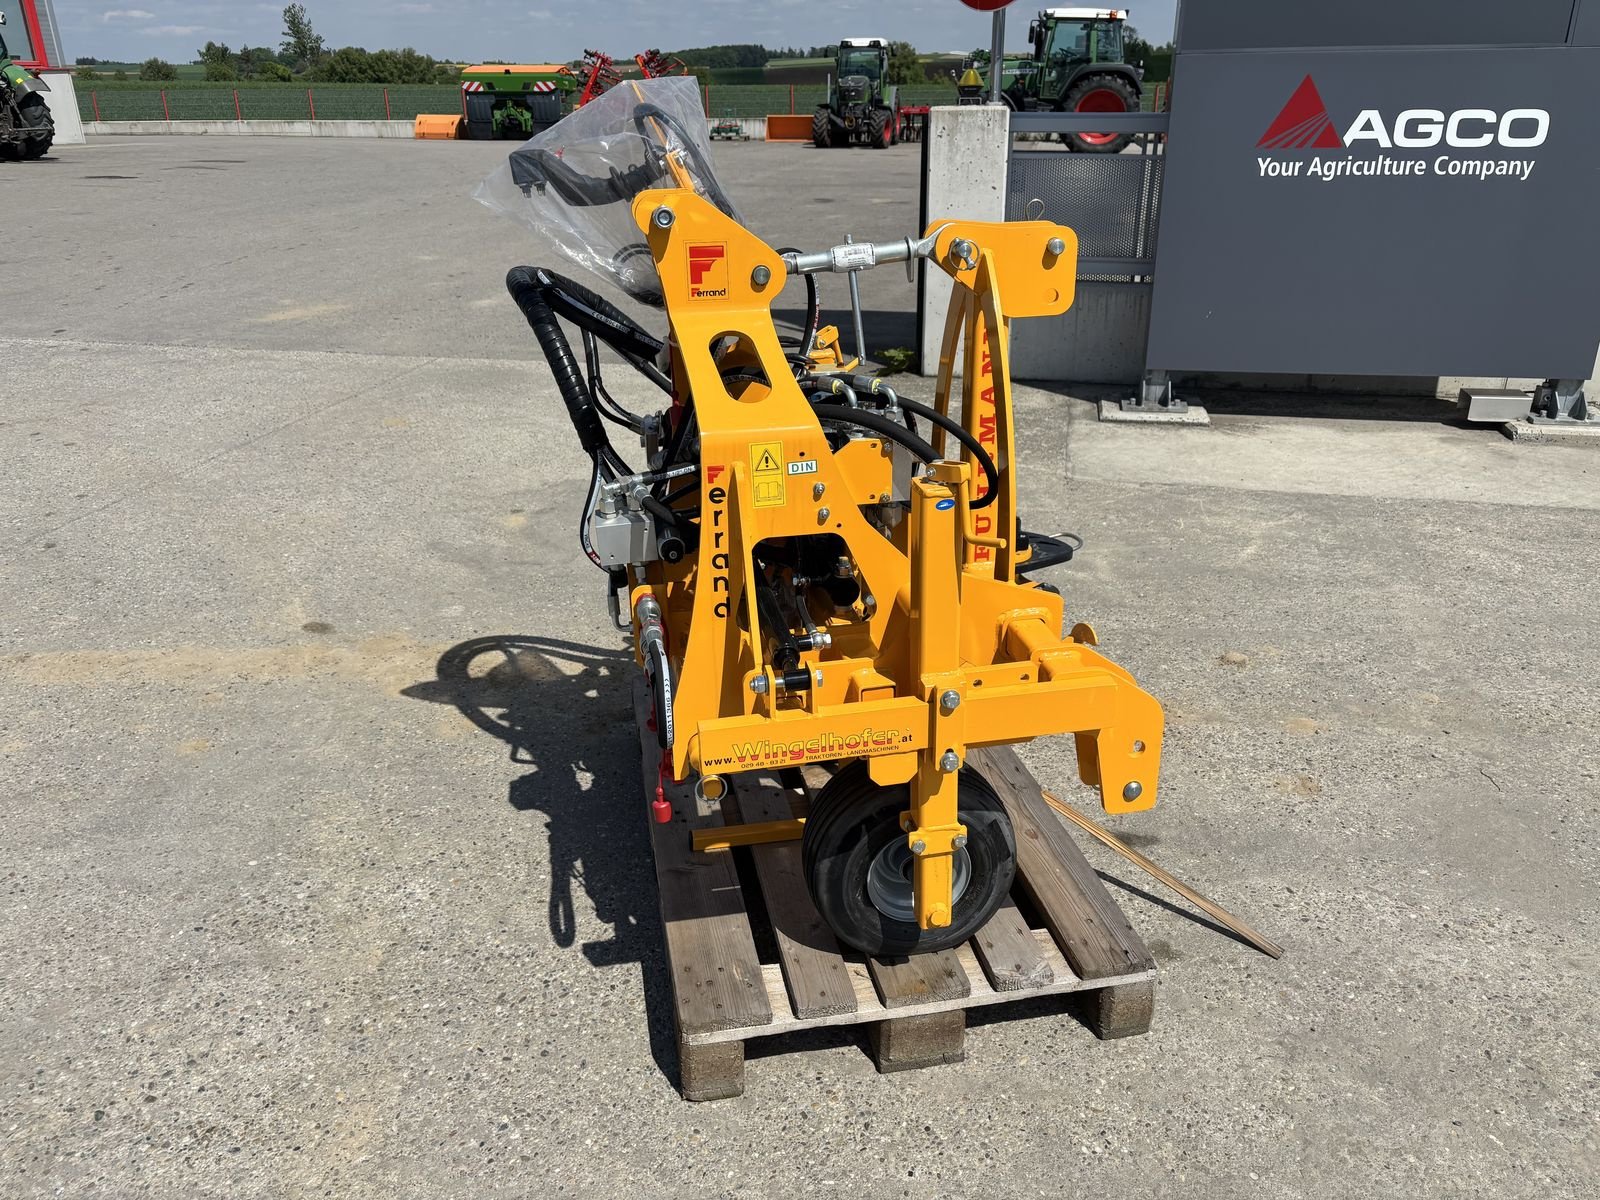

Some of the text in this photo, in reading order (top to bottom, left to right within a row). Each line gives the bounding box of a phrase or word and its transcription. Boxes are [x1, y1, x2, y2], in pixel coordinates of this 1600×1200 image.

[1342, 108, 1550, 148] AGCO
[1257, 155, 1535, 181] Your Agriculture Company
[691, 287, 727, 298] Ferrand
[791, 460, 814, 473] DIN
[706, 465, 731, 618] Ferrand
[805, 752, 842, 761] TRAKTOREN
[847, 745, 899, 756] LANDMASCHINEN
